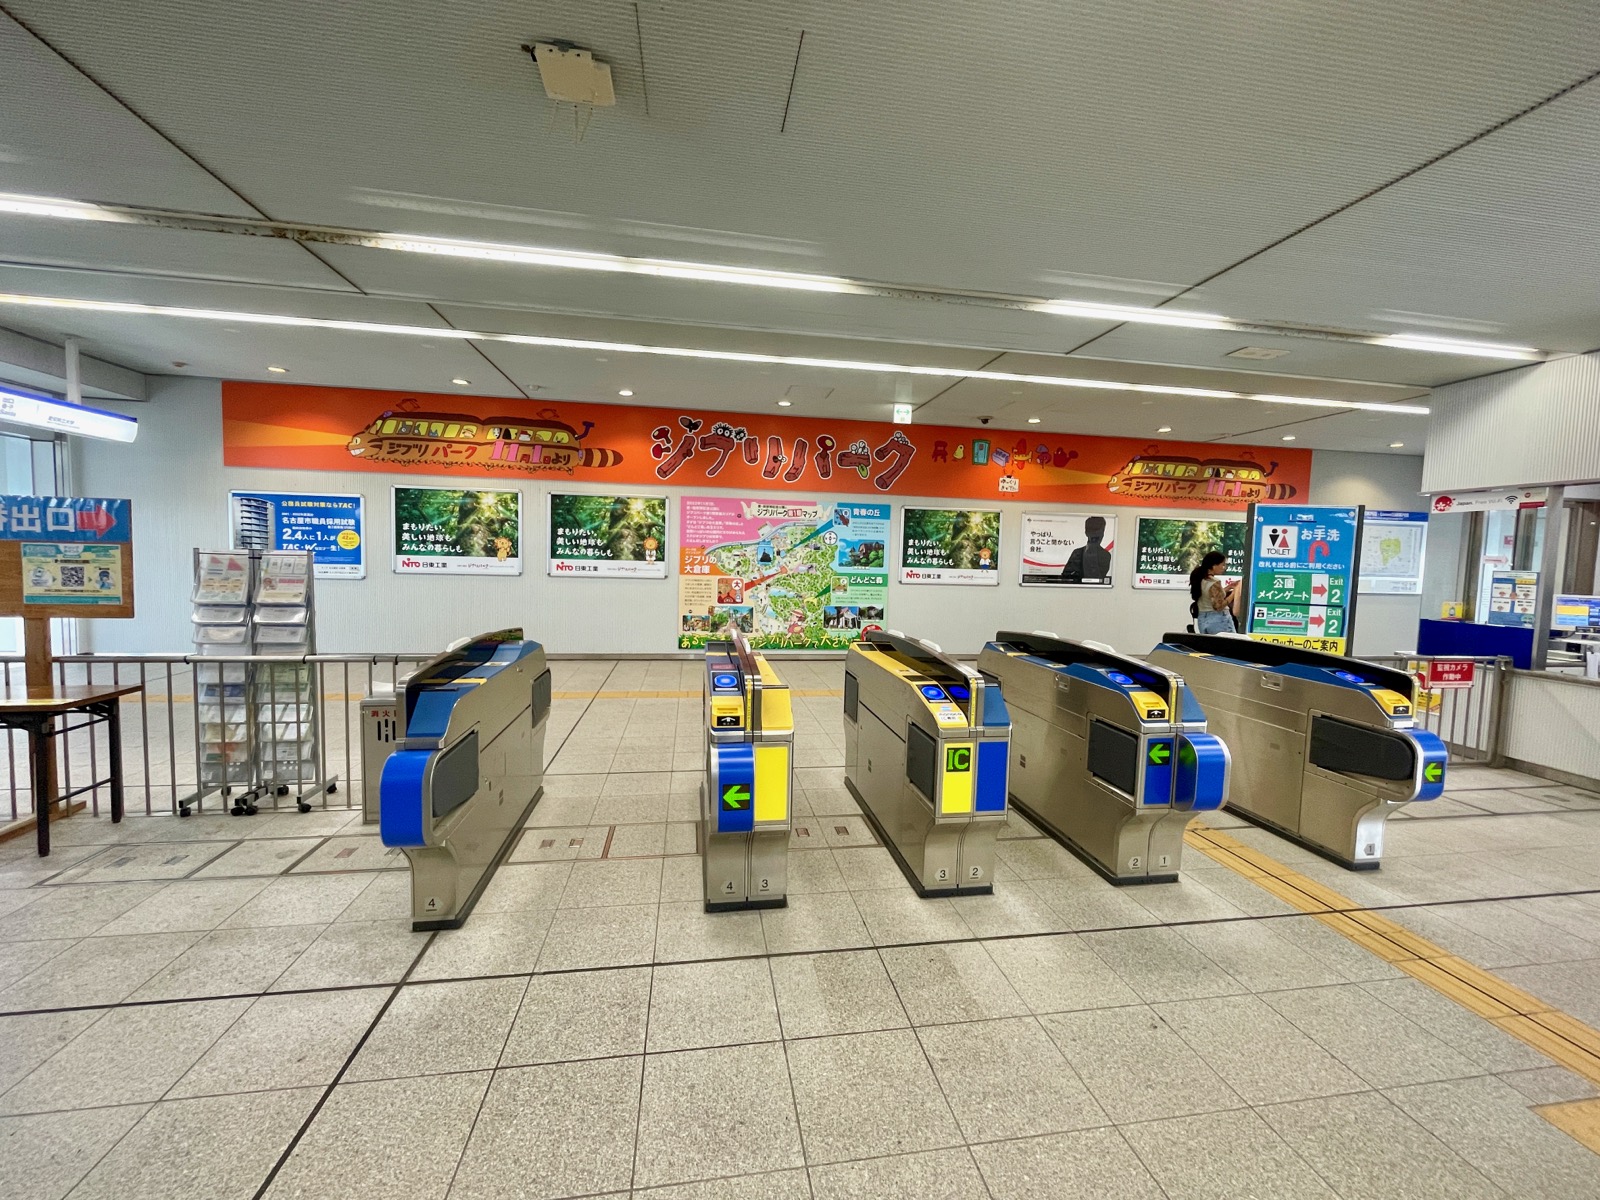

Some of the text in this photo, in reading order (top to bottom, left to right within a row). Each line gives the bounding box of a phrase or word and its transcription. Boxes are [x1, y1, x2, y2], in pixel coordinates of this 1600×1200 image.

[386, 441, 477, 460] ジブリパーク
[650, 416, 916, 490] ジブリパーク
[1134, 481, 1197, 495] ジブリパーク
[0, 503, 76, 532] 出口
[1301, 525, 1340, 541] お手洗
[685, 556, 717, 564] ジブリの
[1257, 590, 1309, 600] メインゲート
[1331, 589, 1340, 602] 2
[1327, 608, 1341, 616] Exit
[1328, 619, 1338, 633] 2
[371, 709, 397, 717] 消火
[947, 749, 969, 770] IC
[1132, 858, 1139, 866] 2
[939, 870, 946, 878] 3
[972, 867, 979, 876] 2
[726, 881, 733, 890] 4
[761, 879, 769, 888] 3
[428, 898, 436, 908] 4
